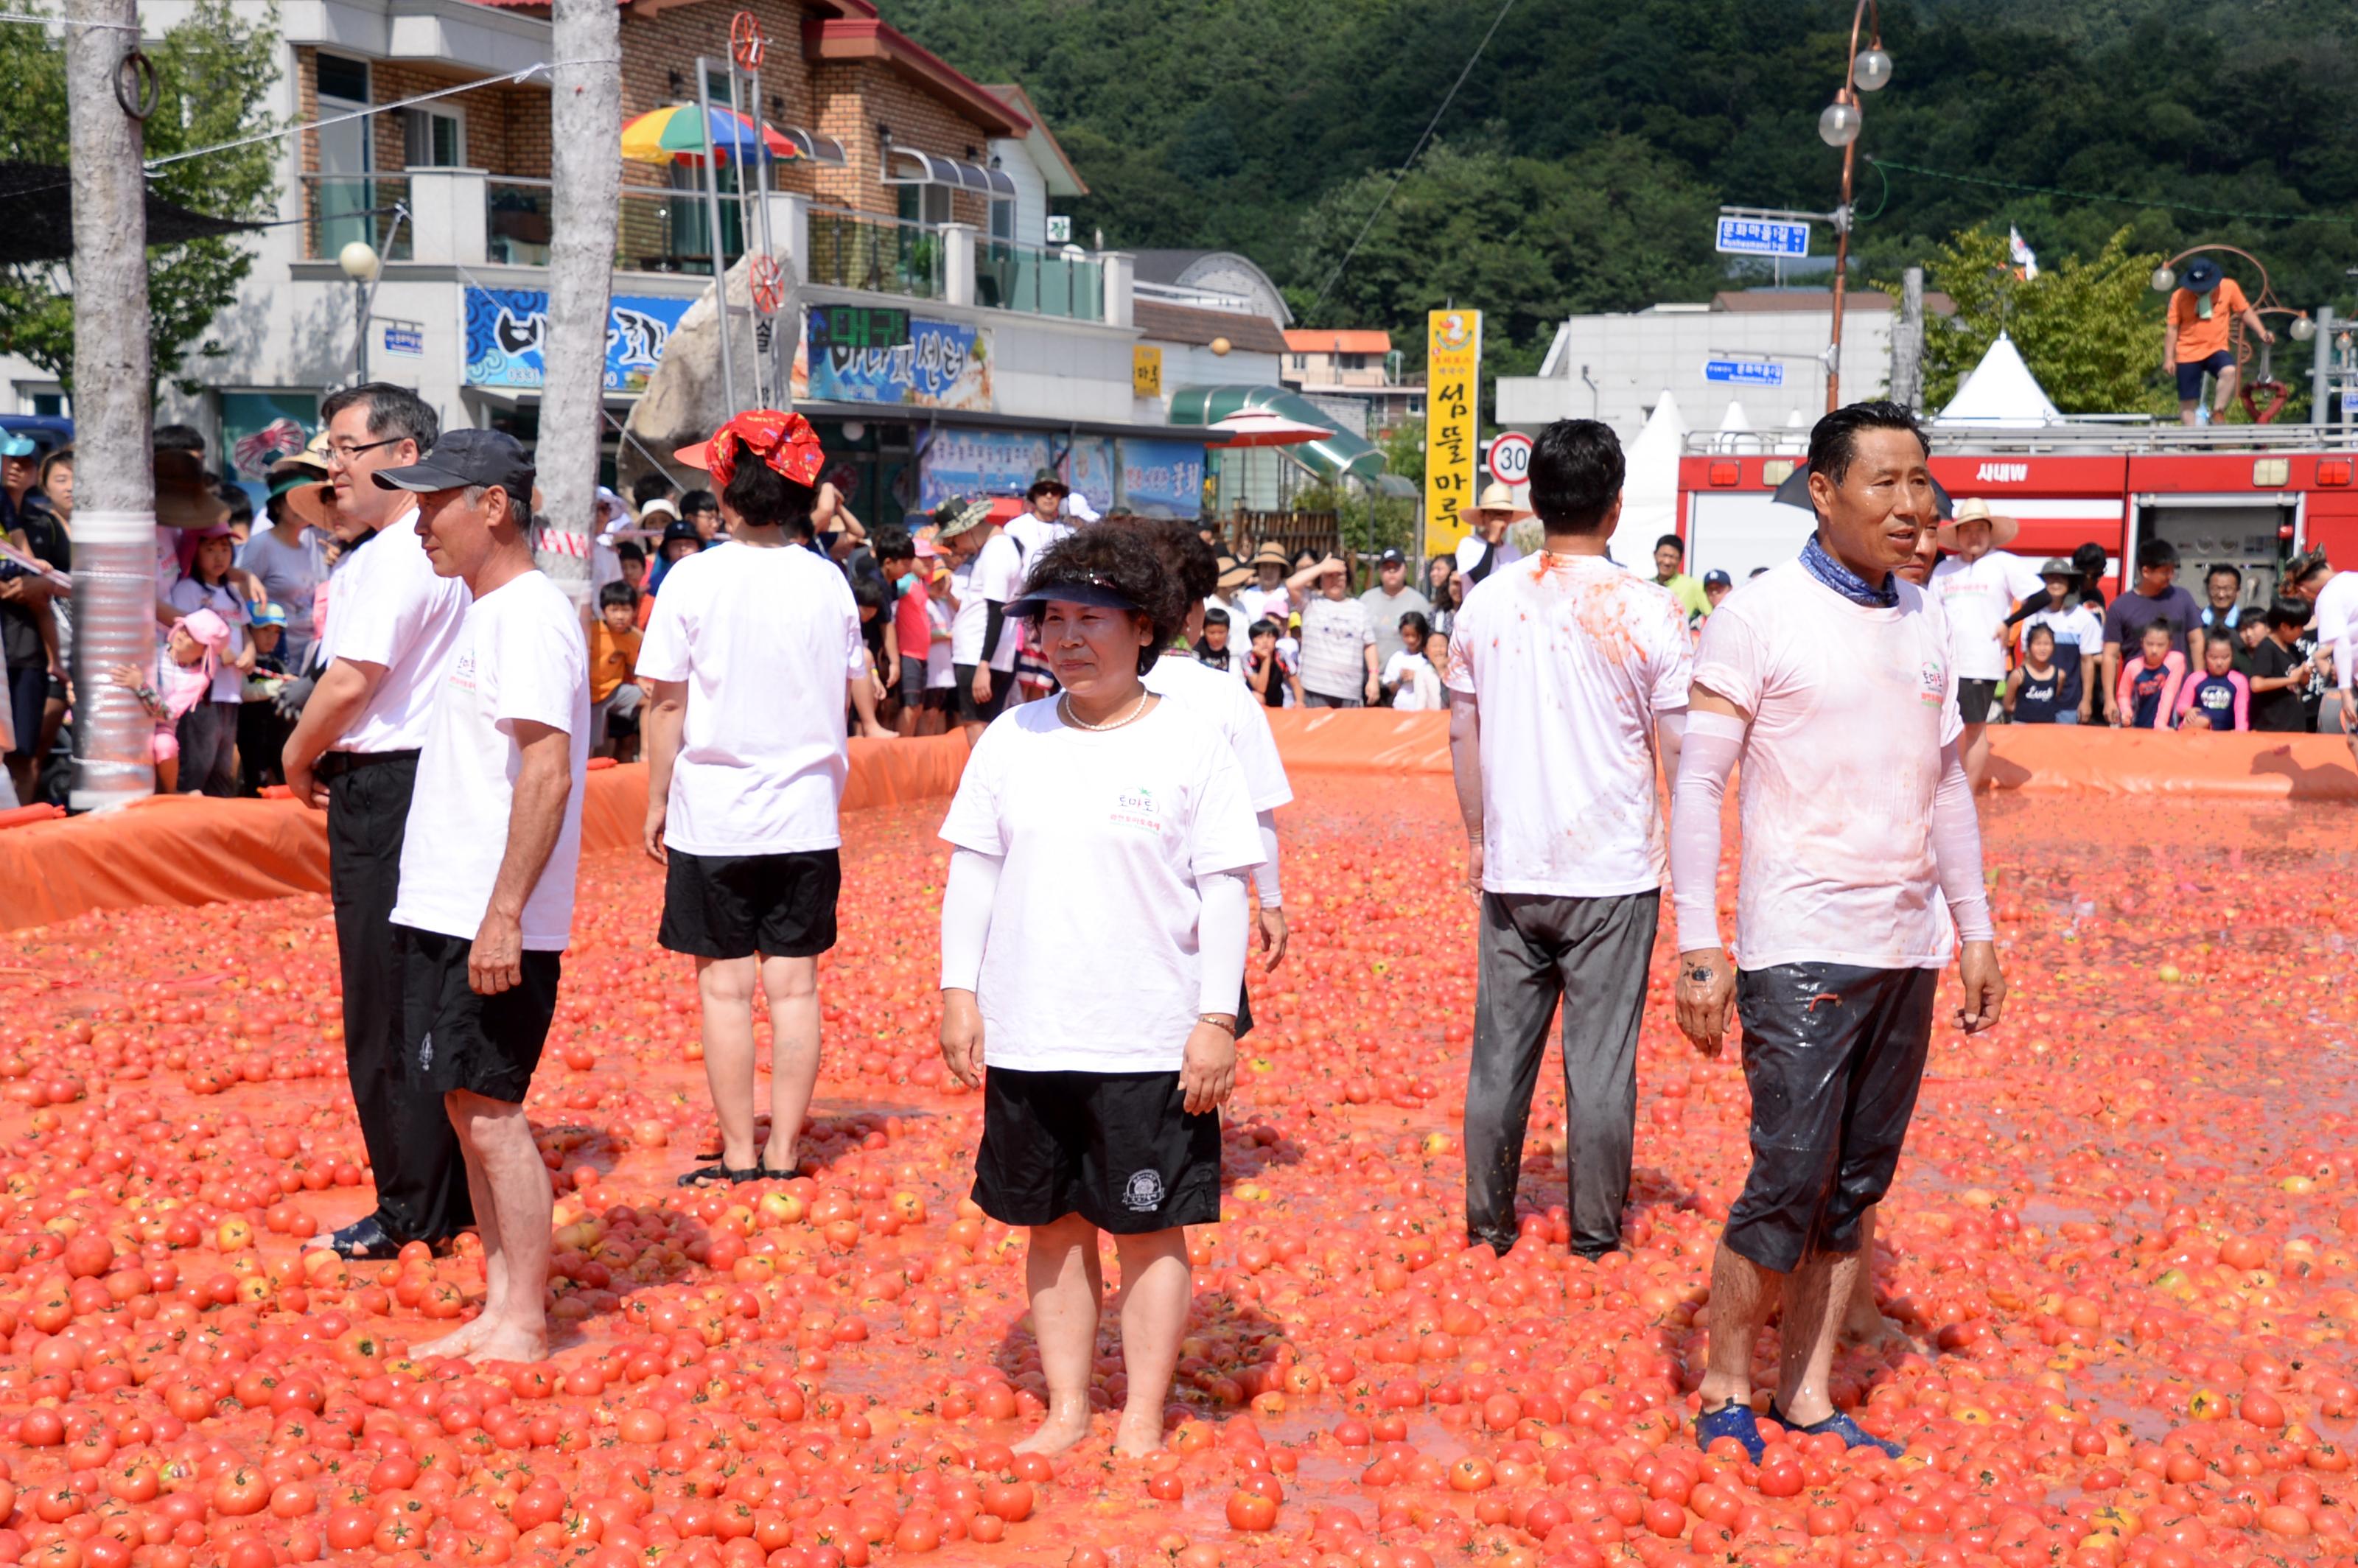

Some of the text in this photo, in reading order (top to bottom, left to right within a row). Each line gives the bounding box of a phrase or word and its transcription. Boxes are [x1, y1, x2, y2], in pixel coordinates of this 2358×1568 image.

[1049, 220, 1067, 239] 장
[1435, 383, 1467, 528] 섬뜰마루
[1500, 447, 1527, 471] 30
